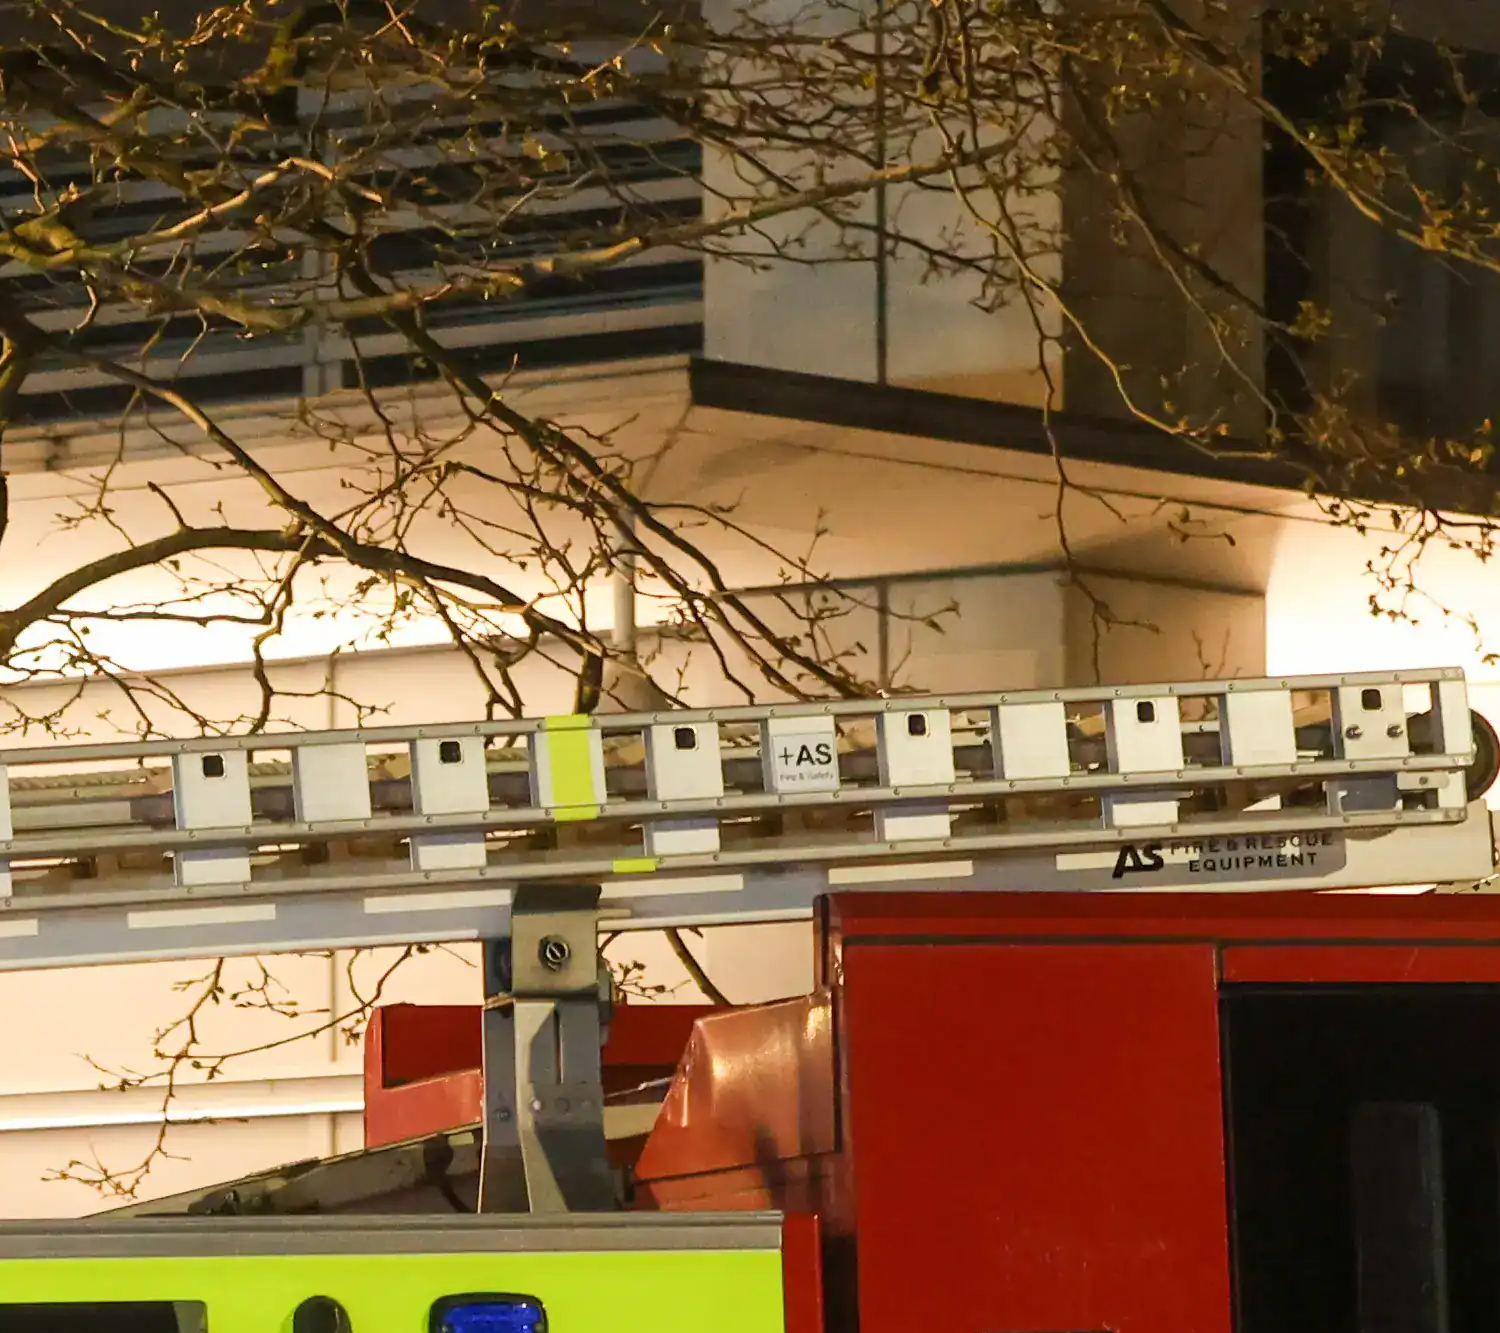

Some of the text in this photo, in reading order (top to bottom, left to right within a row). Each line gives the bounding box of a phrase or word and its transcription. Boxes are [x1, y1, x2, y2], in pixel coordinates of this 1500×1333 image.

[1246, 832, 1332, 849] RESCUE
[1112, 844, 1164, 879] AS
[1189, 852, 1317, 872] EQUIPMENT
